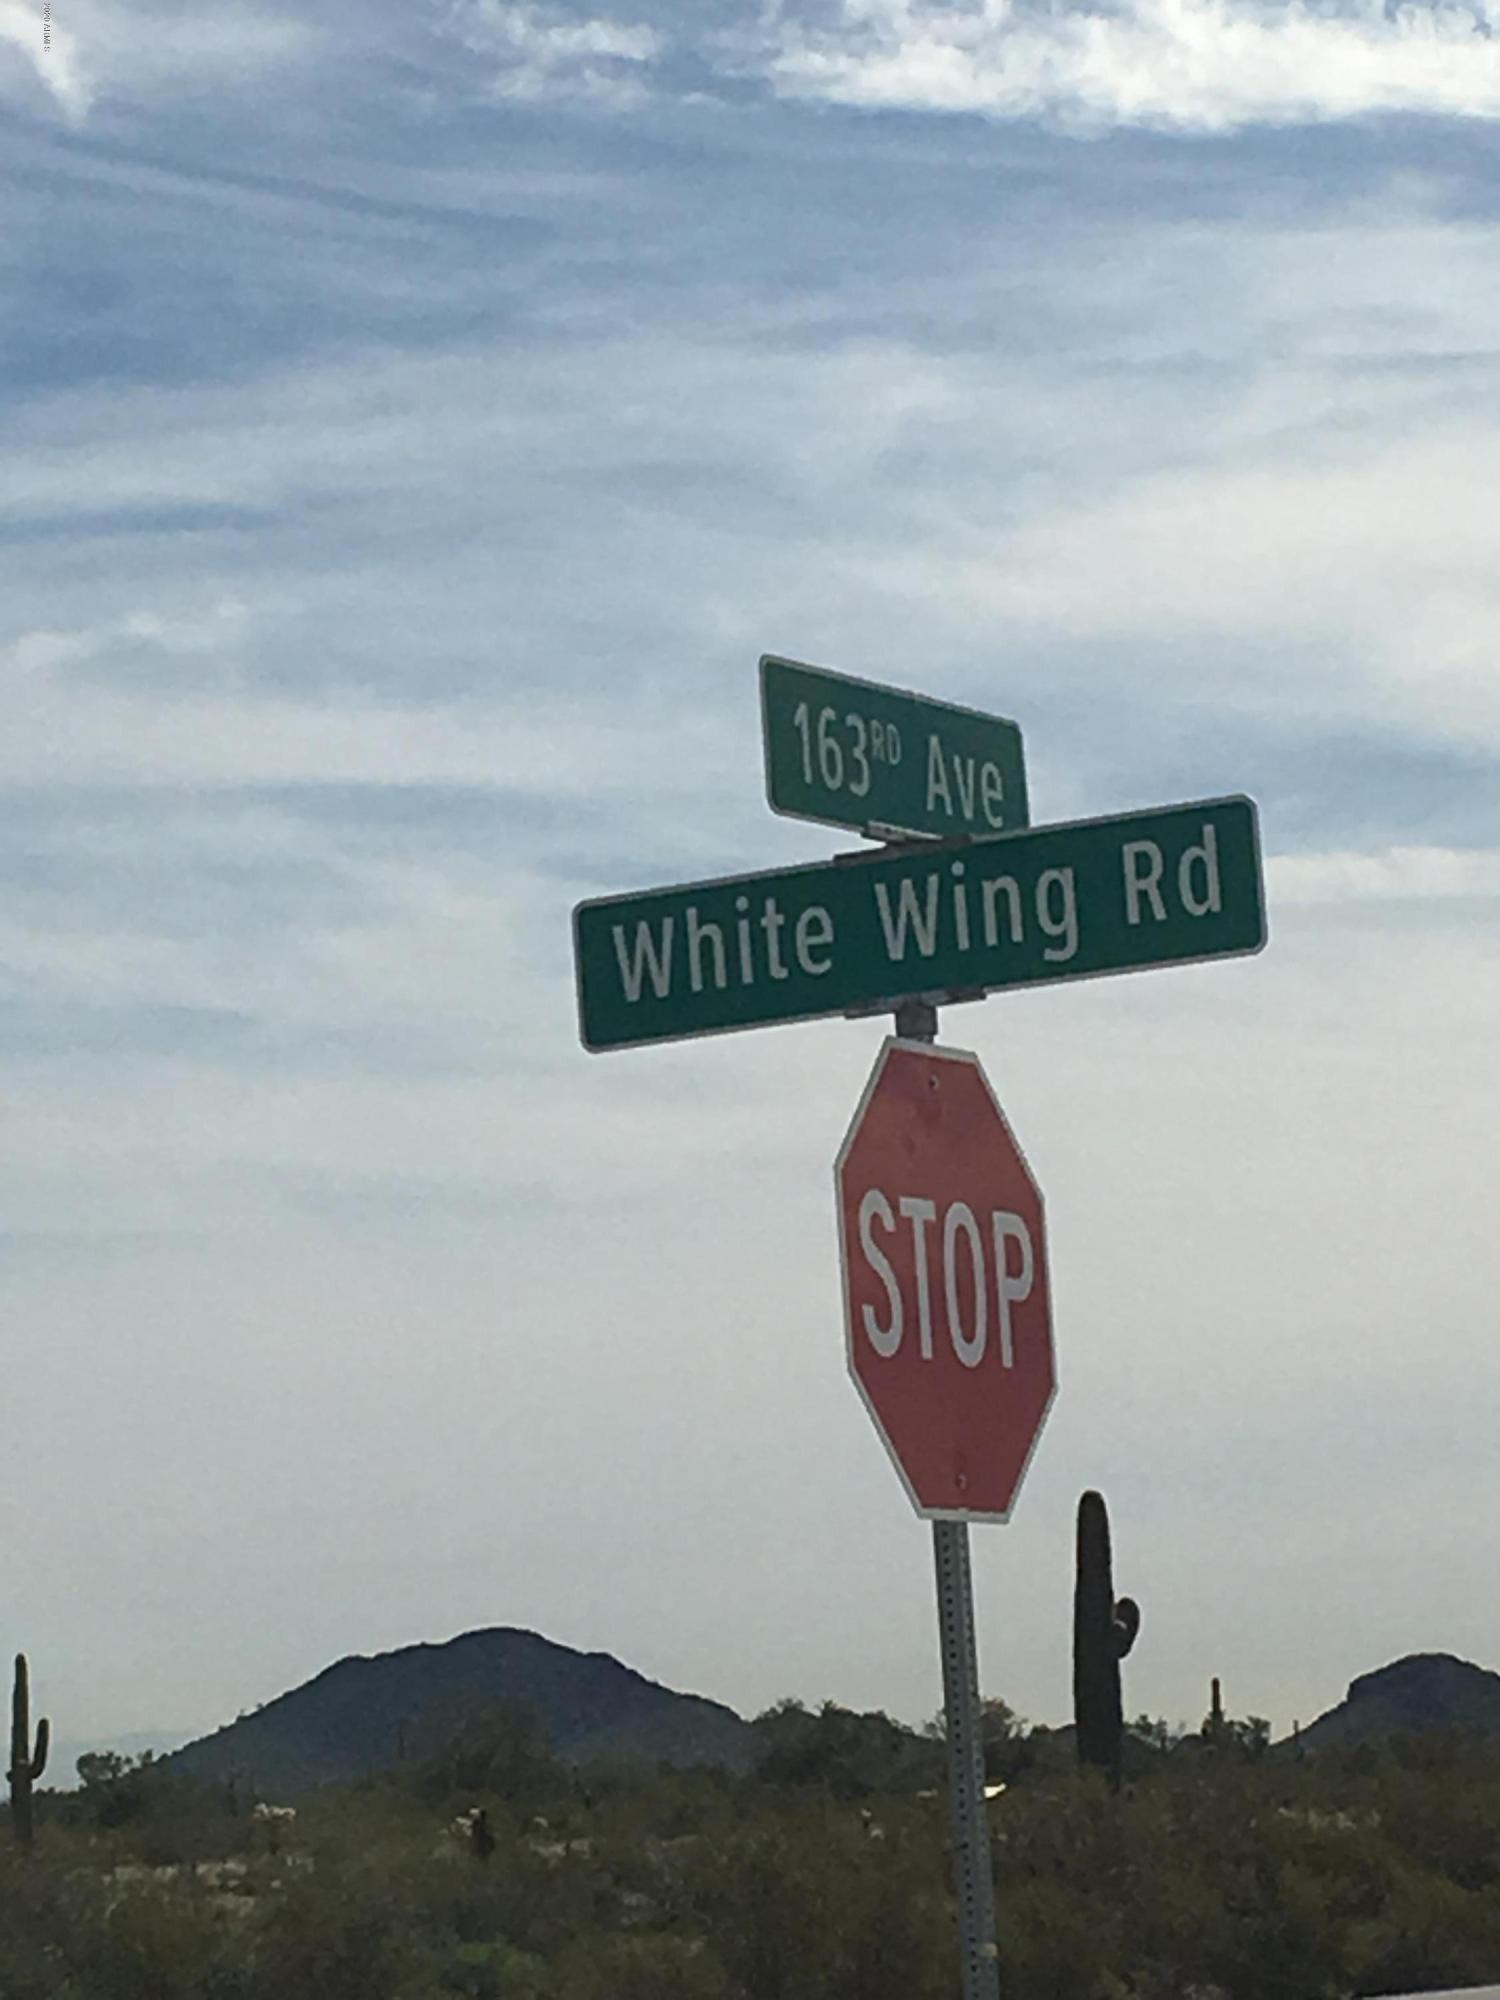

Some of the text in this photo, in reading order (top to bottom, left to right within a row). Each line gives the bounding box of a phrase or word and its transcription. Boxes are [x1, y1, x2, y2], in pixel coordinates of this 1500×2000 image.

[926, 734, 1004, 828] Ave
[612, 823, 1222, 1003] White Wing Rd
[859, 1188, 1034, 1369] STOP
